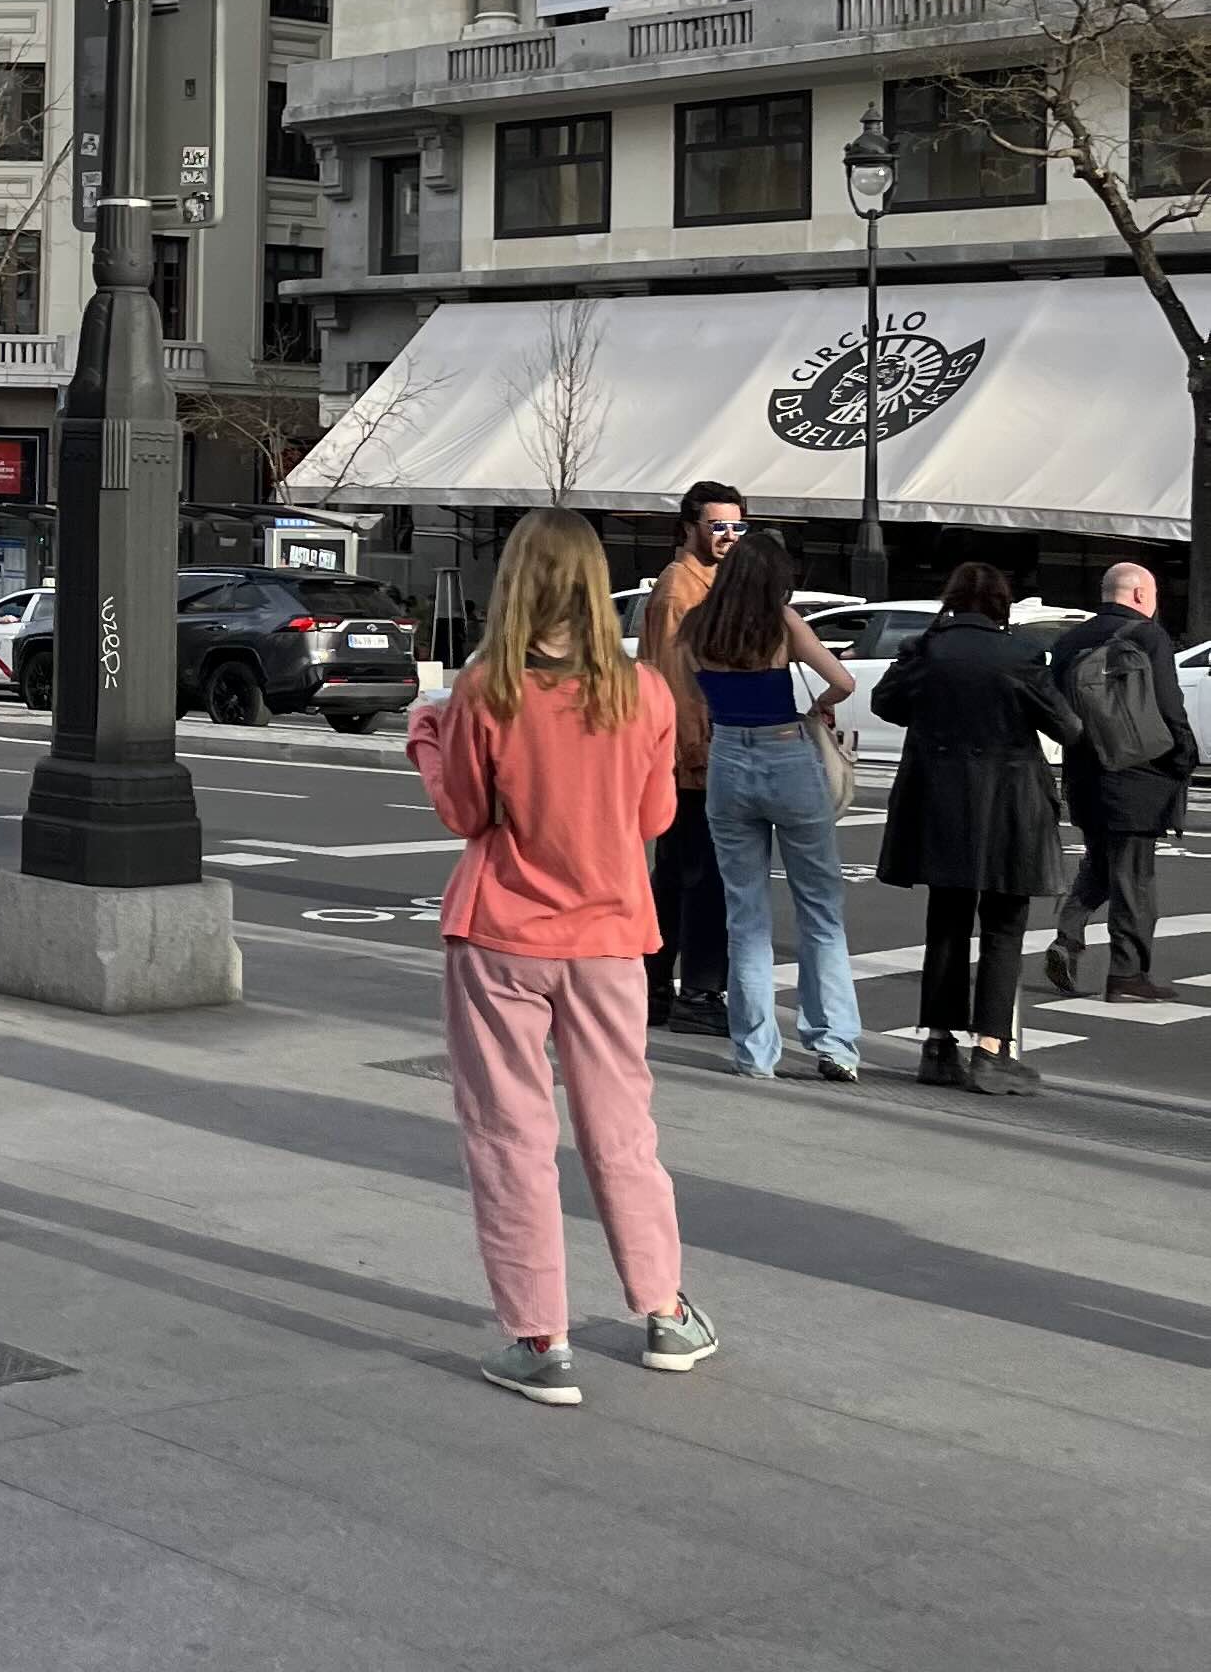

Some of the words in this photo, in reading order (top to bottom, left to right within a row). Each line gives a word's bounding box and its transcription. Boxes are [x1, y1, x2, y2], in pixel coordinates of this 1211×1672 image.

[907, 352, 977, 424] ARTES
[775, 394, 804, 423] DE
[785, 419, 889, 447] BELLAS
